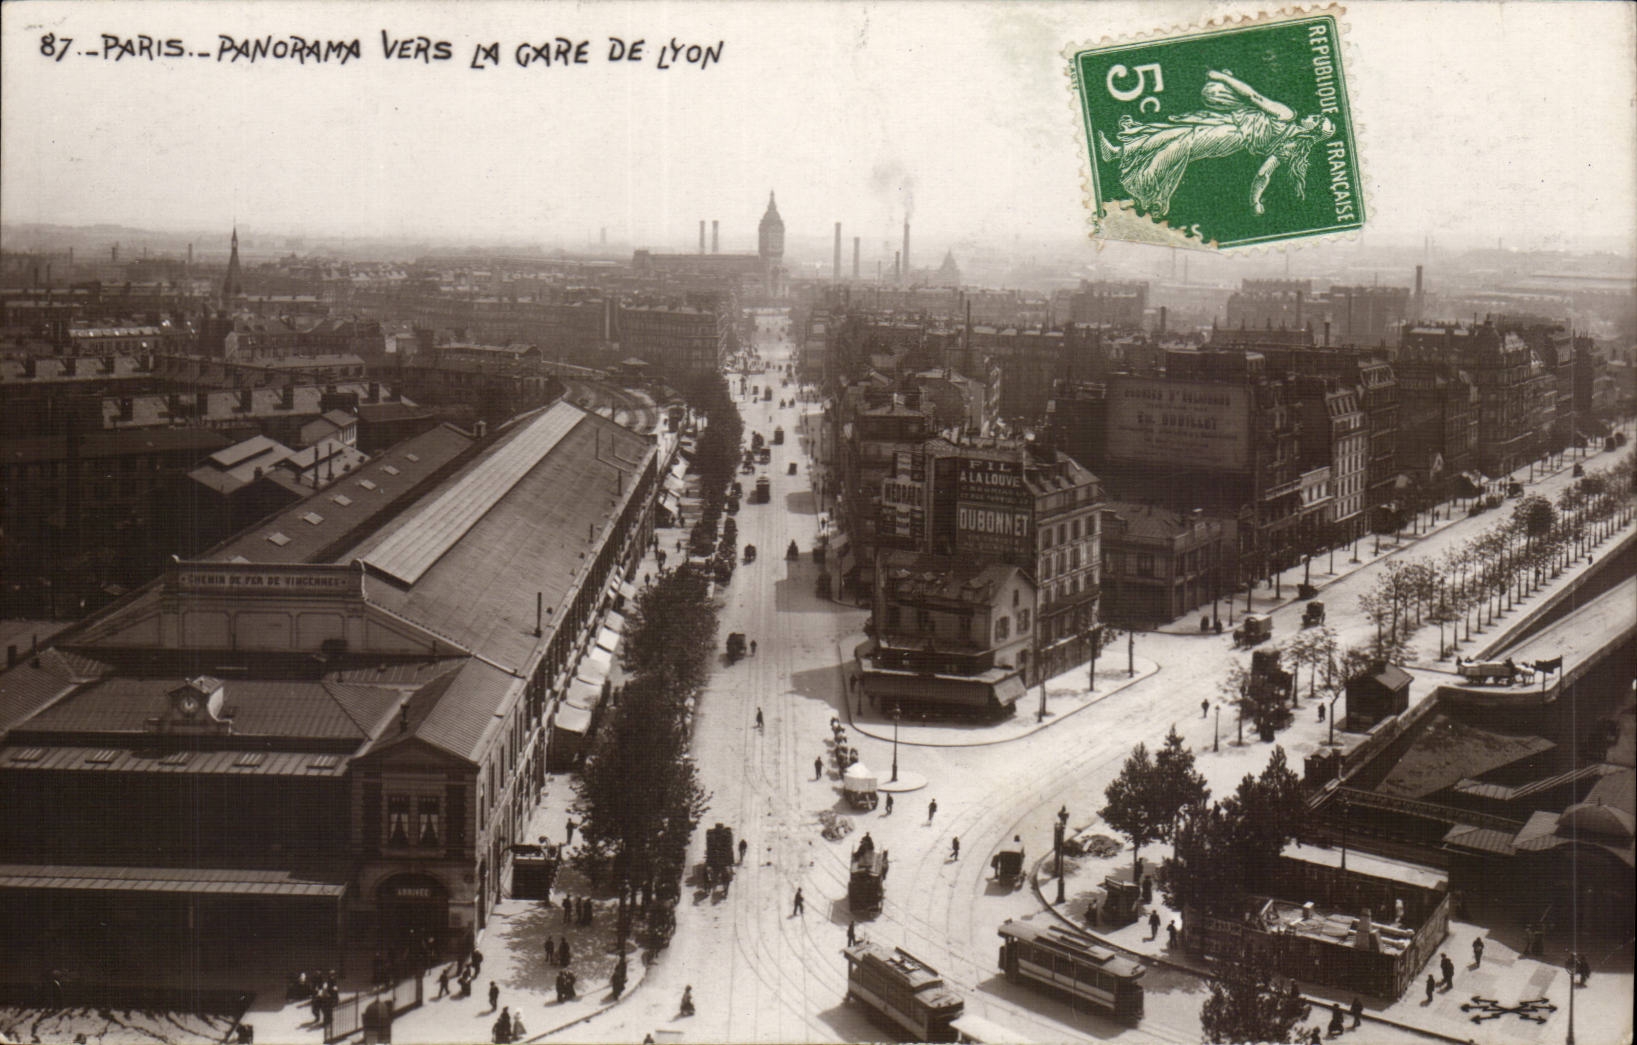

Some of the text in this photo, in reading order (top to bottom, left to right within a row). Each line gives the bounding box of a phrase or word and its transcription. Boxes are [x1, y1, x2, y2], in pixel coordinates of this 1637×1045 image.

[1326, 140, 1355, 222] FRANÇAISE
[968, 460, 1012, 472] FIL
[969, 471, 983, 484] LA
[985, 473, 1021, 487] LOUVE
[959, 508, 1028, 537] DUBONNET
[188, 575, 340, 587] CHEMIN DE FER DE VINCENNES
